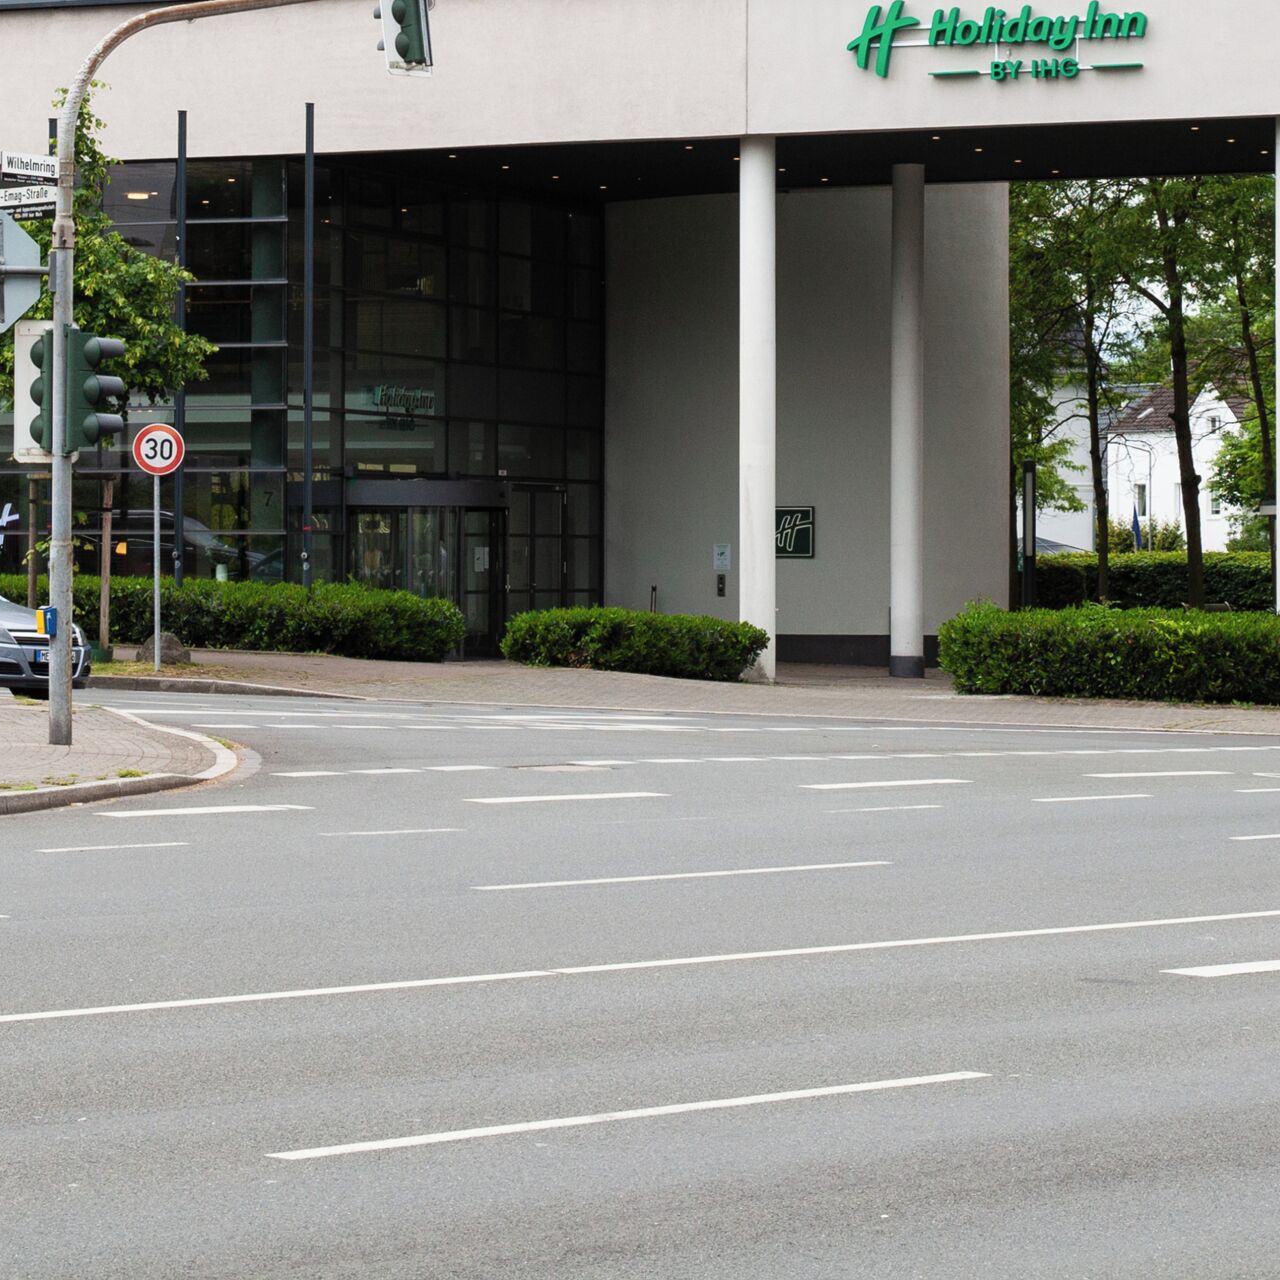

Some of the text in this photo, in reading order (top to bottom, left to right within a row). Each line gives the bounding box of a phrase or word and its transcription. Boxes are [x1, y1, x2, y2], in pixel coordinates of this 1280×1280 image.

[928, 5, 1079, 51] Holiday
[1084, 0, 1148, 39] Inn
[990, 57, 1079, 81] BY IHG
[6, 156, 56, 177] Wilhelmring
[145, 438, 173, 460] 30
[263, 491, 274, 507] 7
